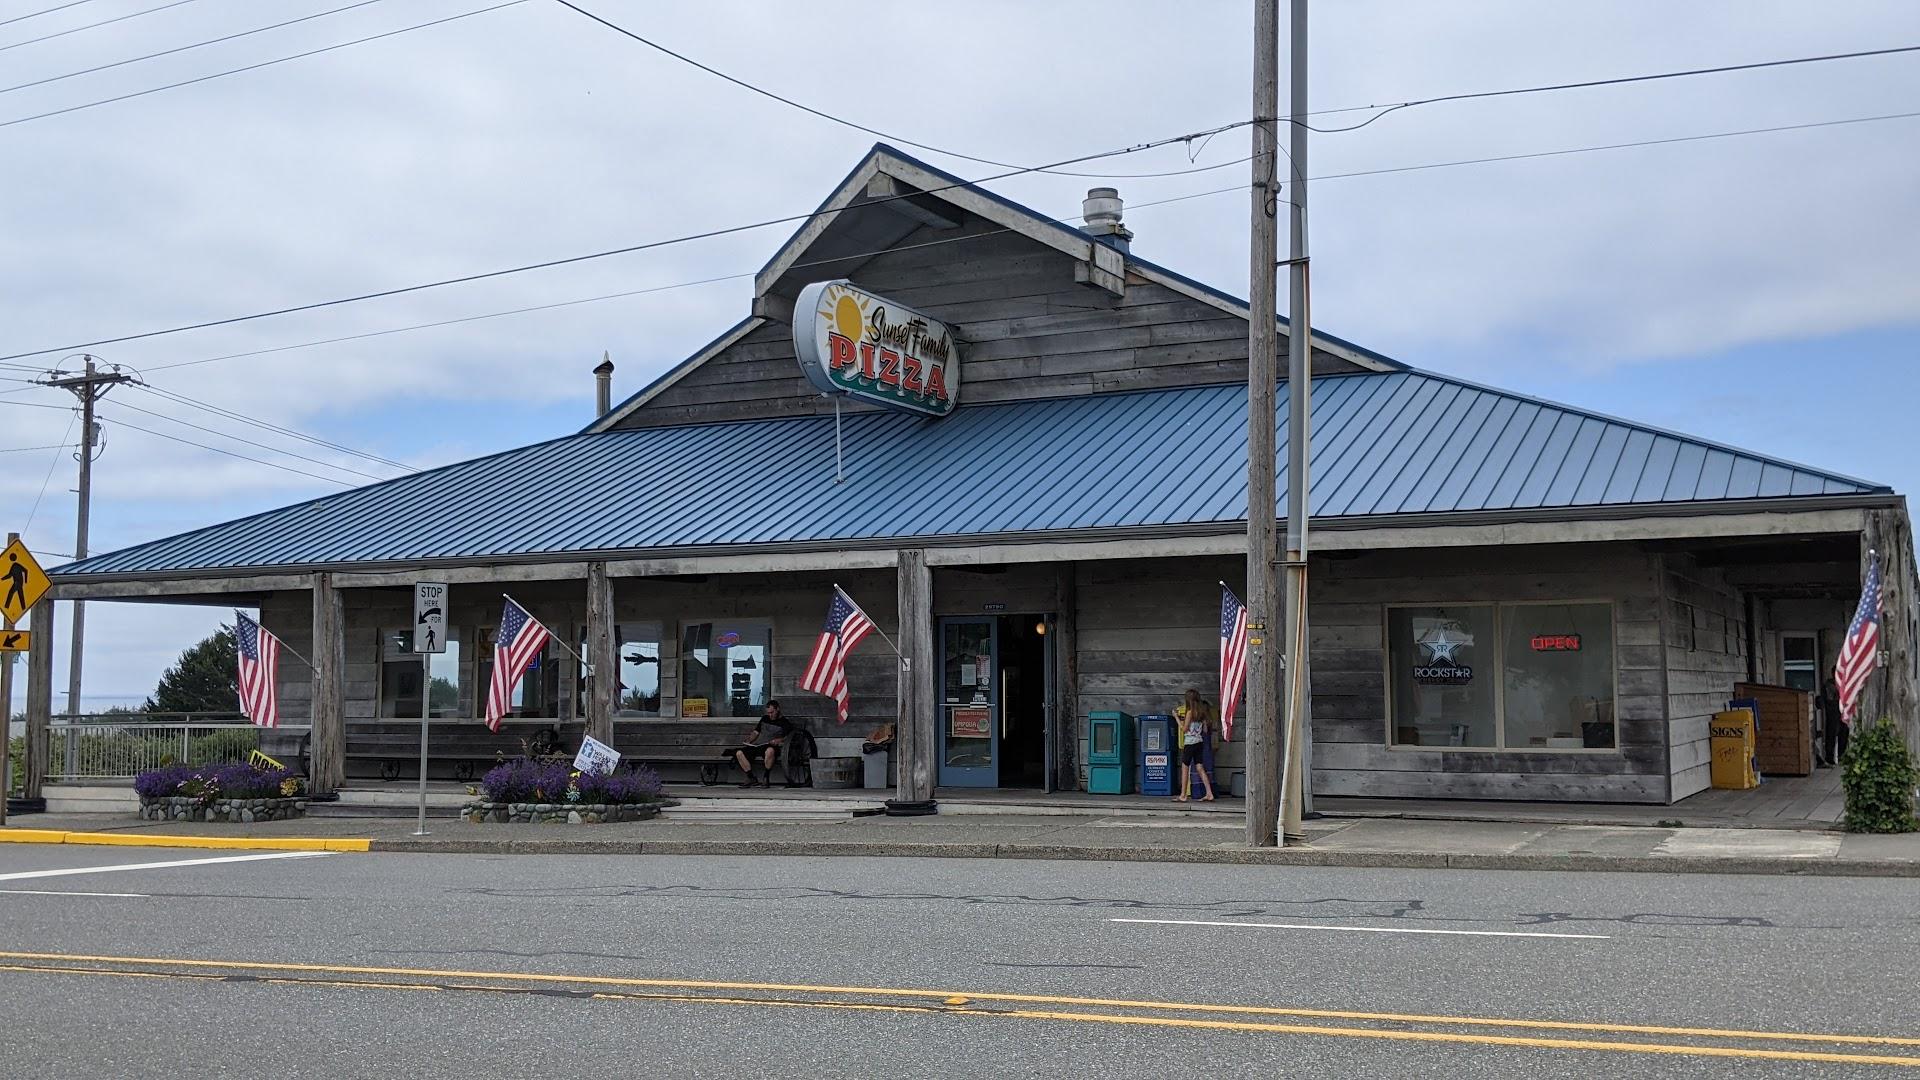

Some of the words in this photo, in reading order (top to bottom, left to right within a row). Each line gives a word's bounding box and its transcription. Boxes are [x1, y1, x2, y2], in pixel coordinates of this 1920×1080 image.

[868, 306, 912, 350] Sunset
[911, 317, 950, 372] Family
[828, 331, 948, 400] PIZZA
[421, 586, 443, 598] STOP
[431, 616, 442, 624] FOR
[1532, 637, 1578, 649] OPEN
[1711, 727, 1744, 738] SIGNS
